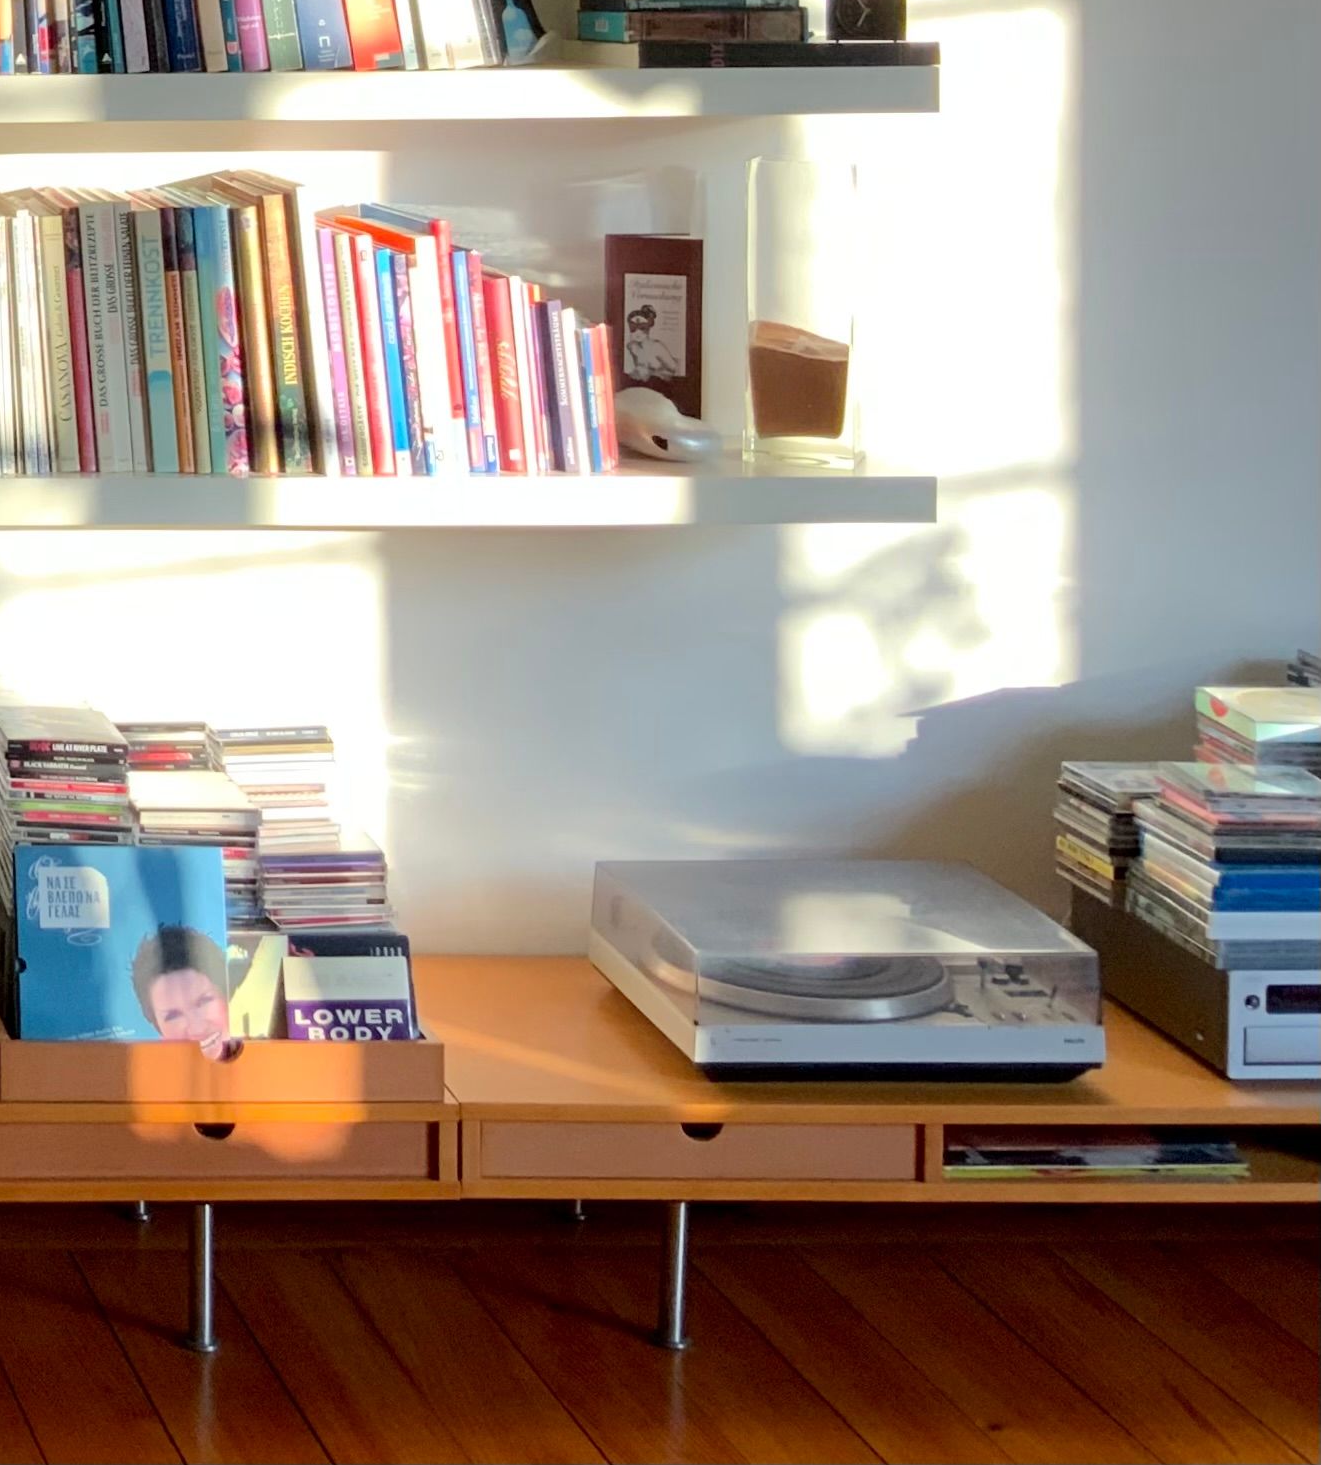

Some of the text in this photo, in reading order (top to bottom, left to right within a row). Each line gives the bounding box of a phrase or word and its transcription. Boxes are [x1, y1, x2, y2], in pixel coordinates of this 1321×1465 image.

[104, 263, 119, 314] DAS GROSSE
[141, 236, 166, 358] TRENNKOST
[85, 213, 109, 408] DAS GROSSE BUCH DER BLITZREZEPTE
[276, 284, 299, 386] INDISCH KOCHEN
[129, 346, 142, 365] DAS
[54, 342, 73, 422] CASANOVA
[23, 761, 42, 769] BLACK
[52, 743, 65, 752] LIVE
[73, 744, 90, 753] RIVER
[90, 745, 108, 754] PLATE
[294, 1009, 404, 1025] LOWER
[308, 1027, 393, 1040] BODY
